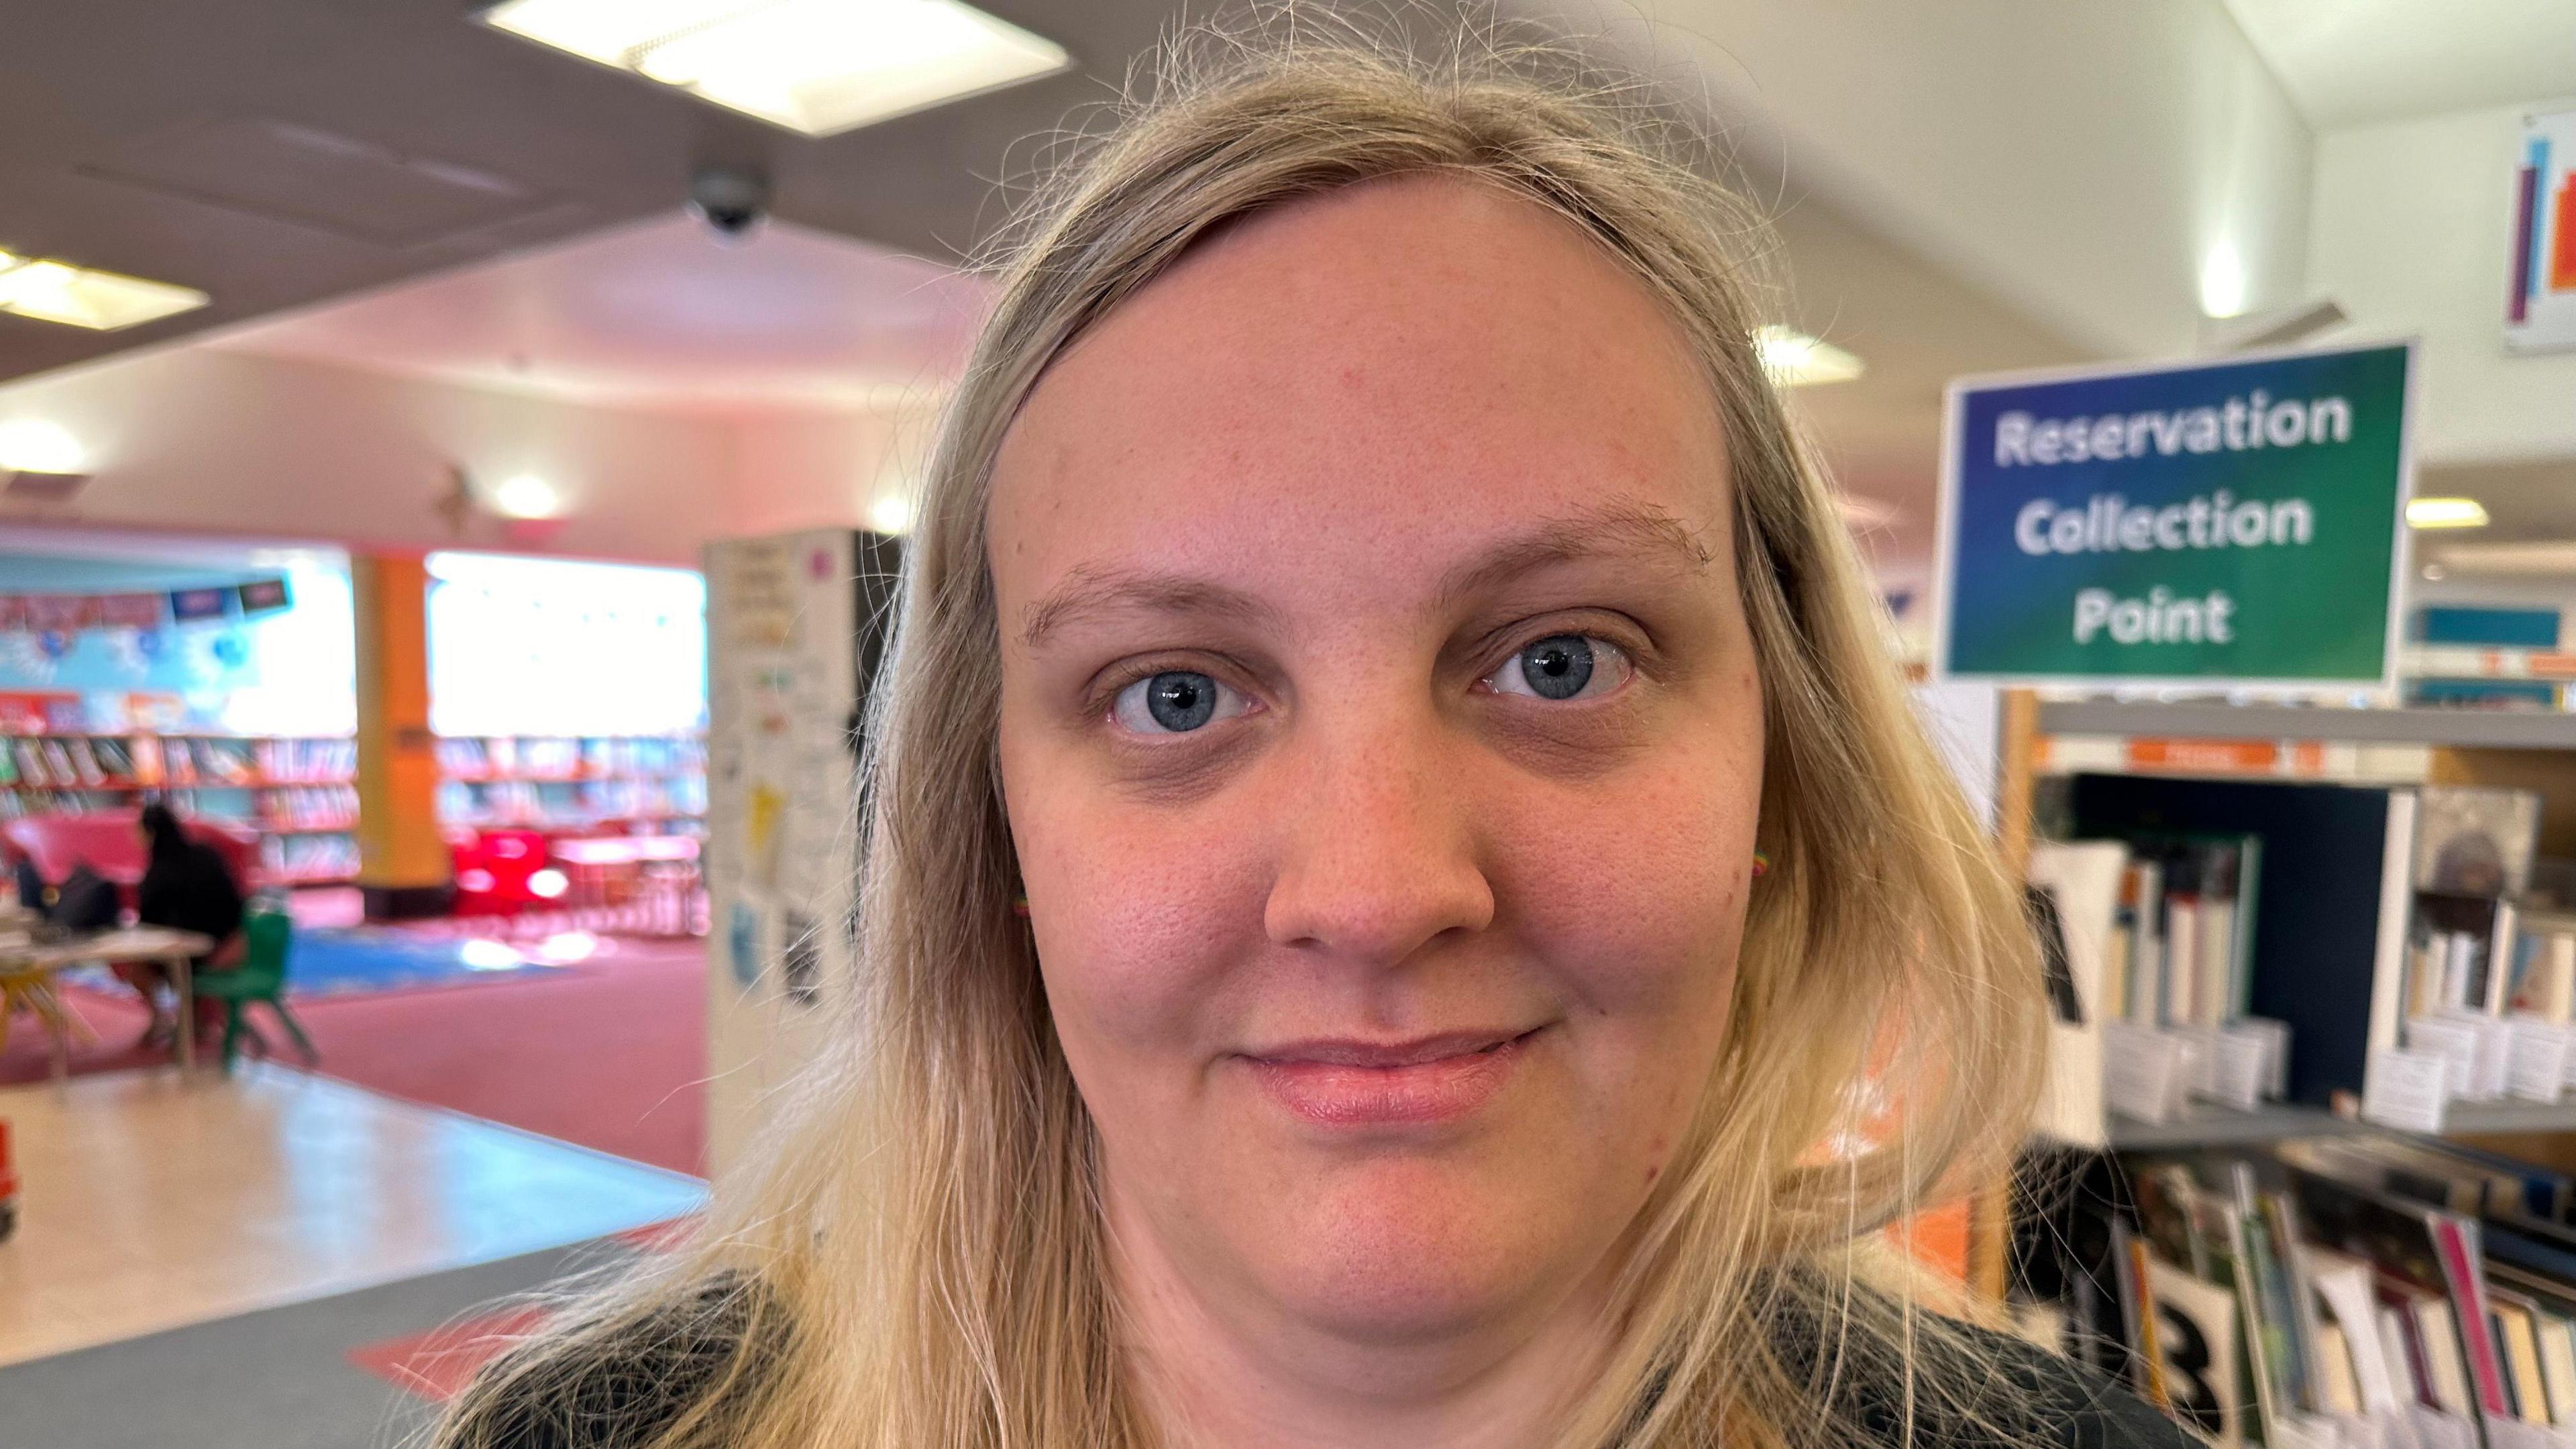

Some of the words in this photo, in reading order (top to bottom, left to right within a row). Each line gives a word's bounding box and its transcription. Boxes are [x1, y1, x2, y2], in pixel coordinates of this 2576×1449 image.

[1995, 389, 2350, 466] Reservation
[2015, 489, 2313, 555] Collection
[2074, 585, 2235, 645] Point
